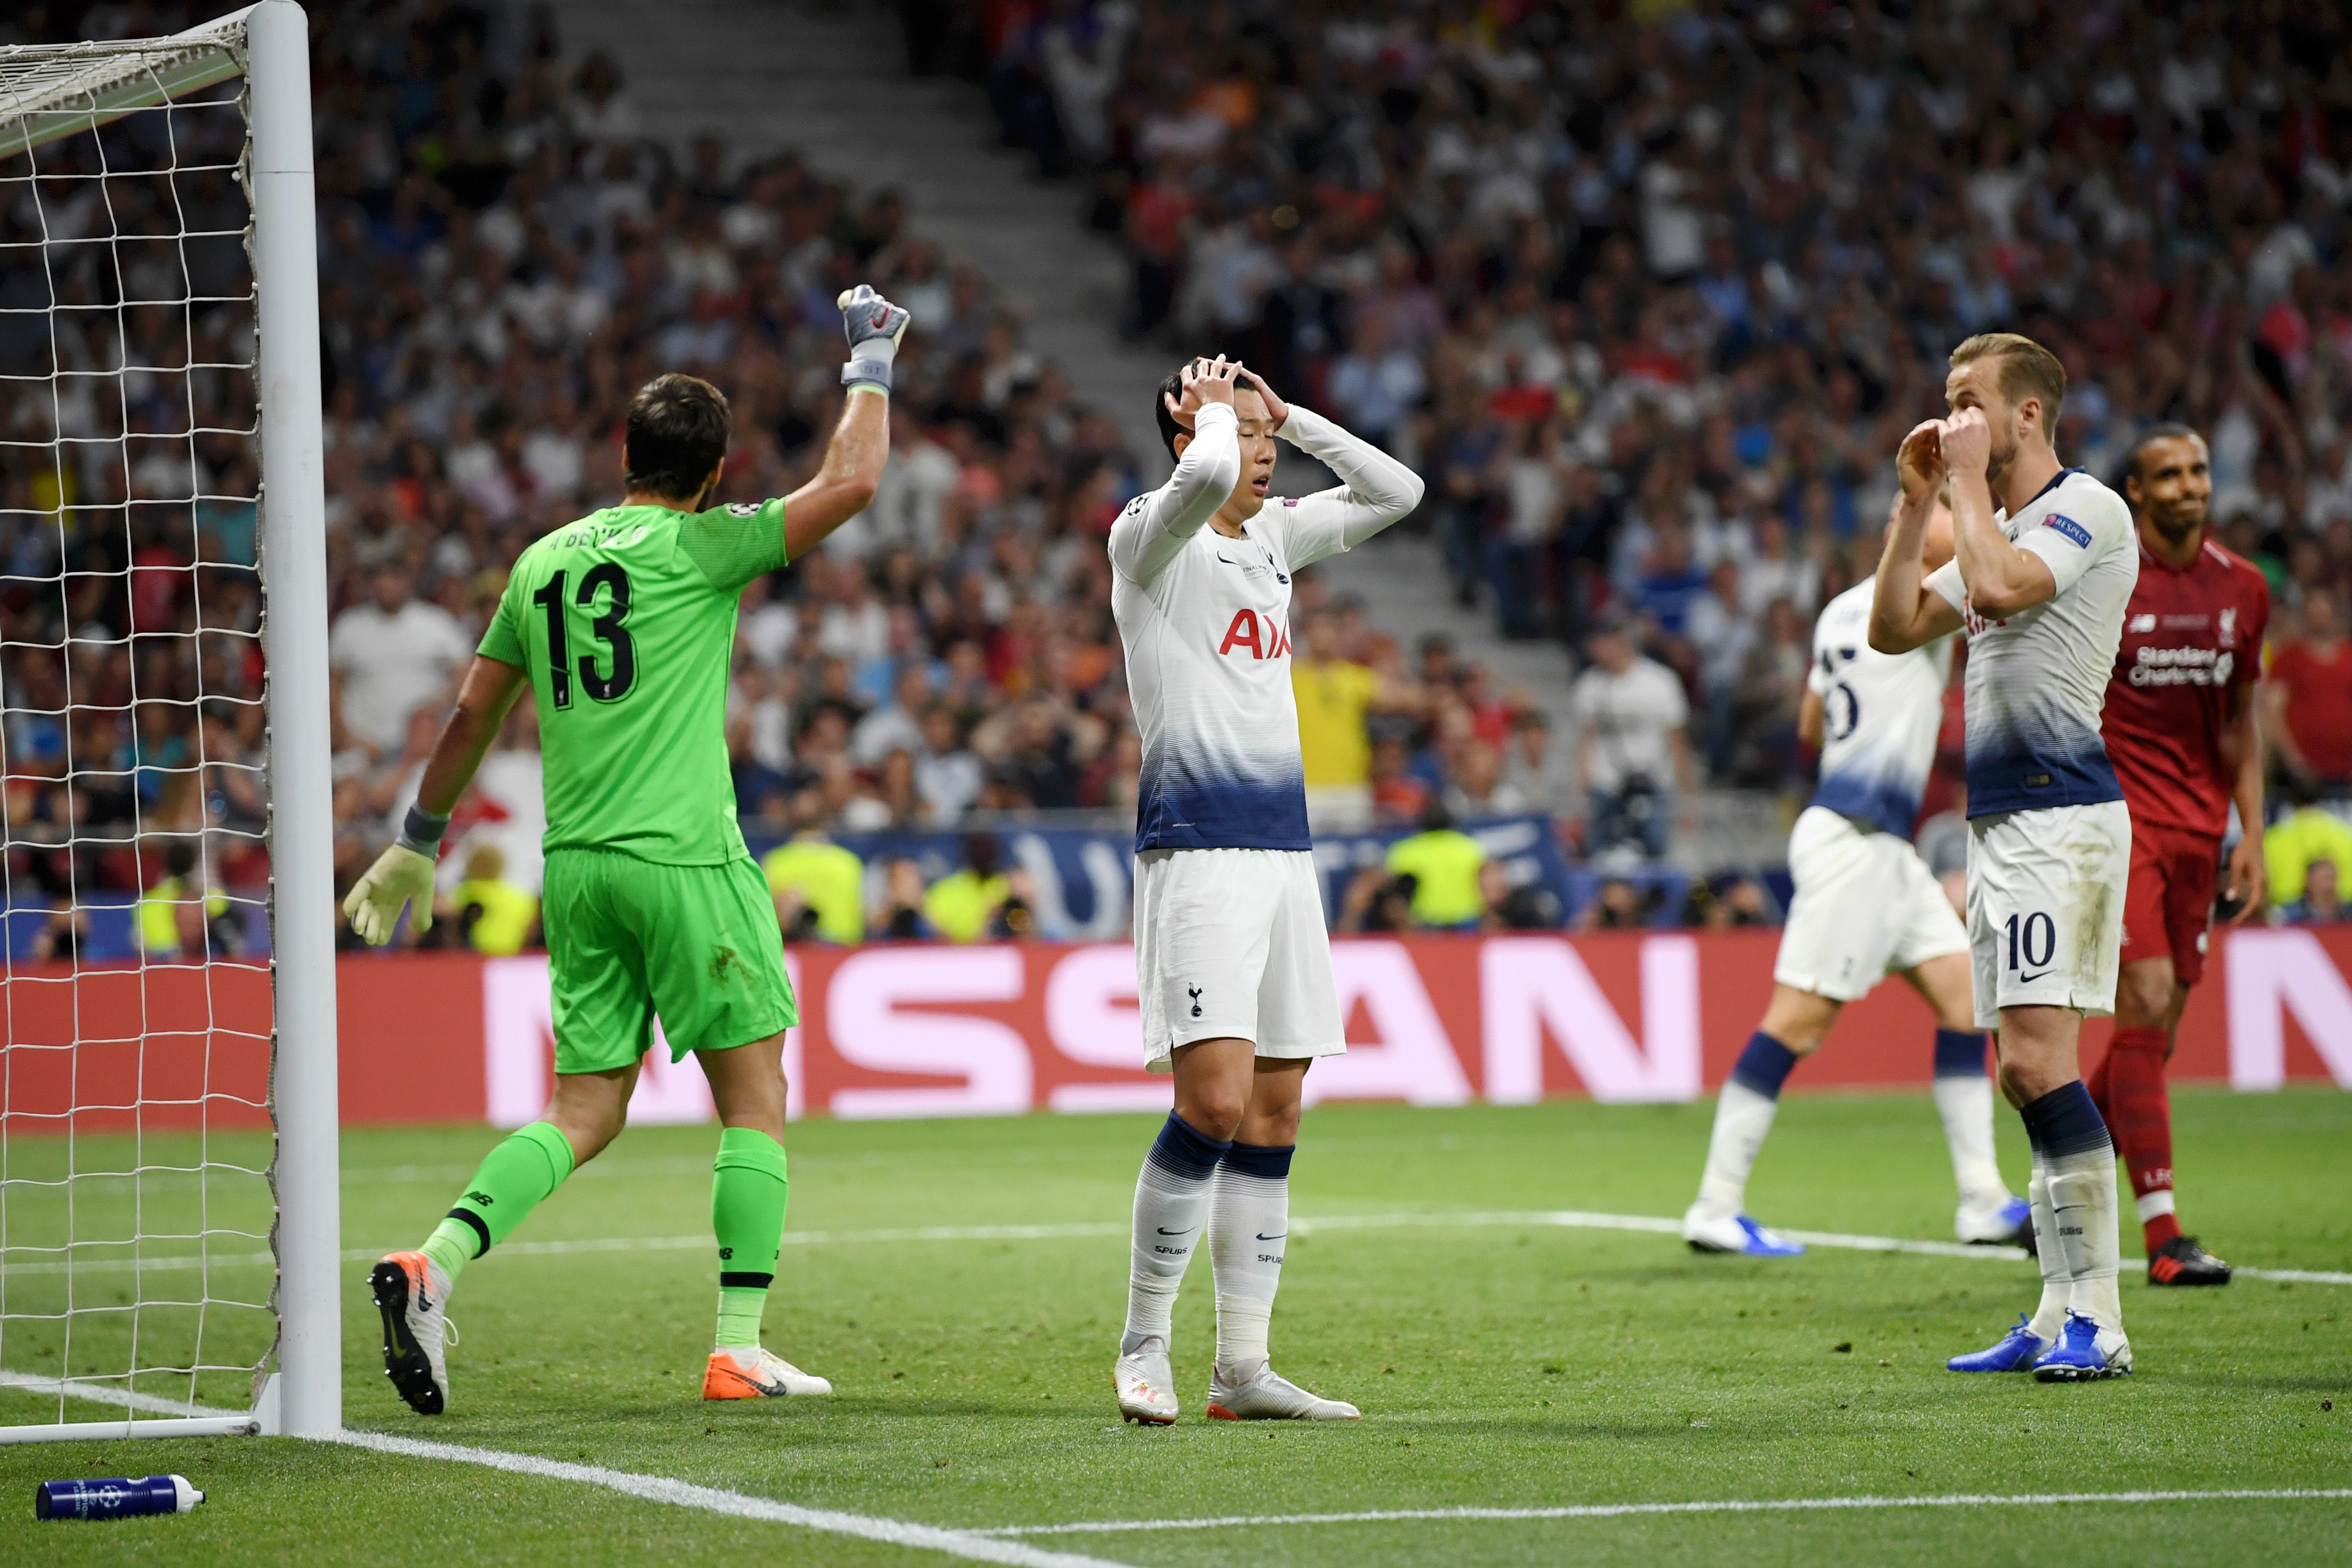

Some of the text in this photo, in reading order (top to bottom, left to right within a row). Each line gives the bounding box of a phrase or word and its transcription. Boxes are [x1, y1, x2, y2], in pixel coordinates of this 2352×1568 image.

[2056, 517, 2091, 545] RESPECT
[534, 562, 639, 711] 13
[2137, 645, 2217, 666] Standard
[2004, 911, 2055, 970] 10
[1155, 1245, 1187, 1255] SPURS
